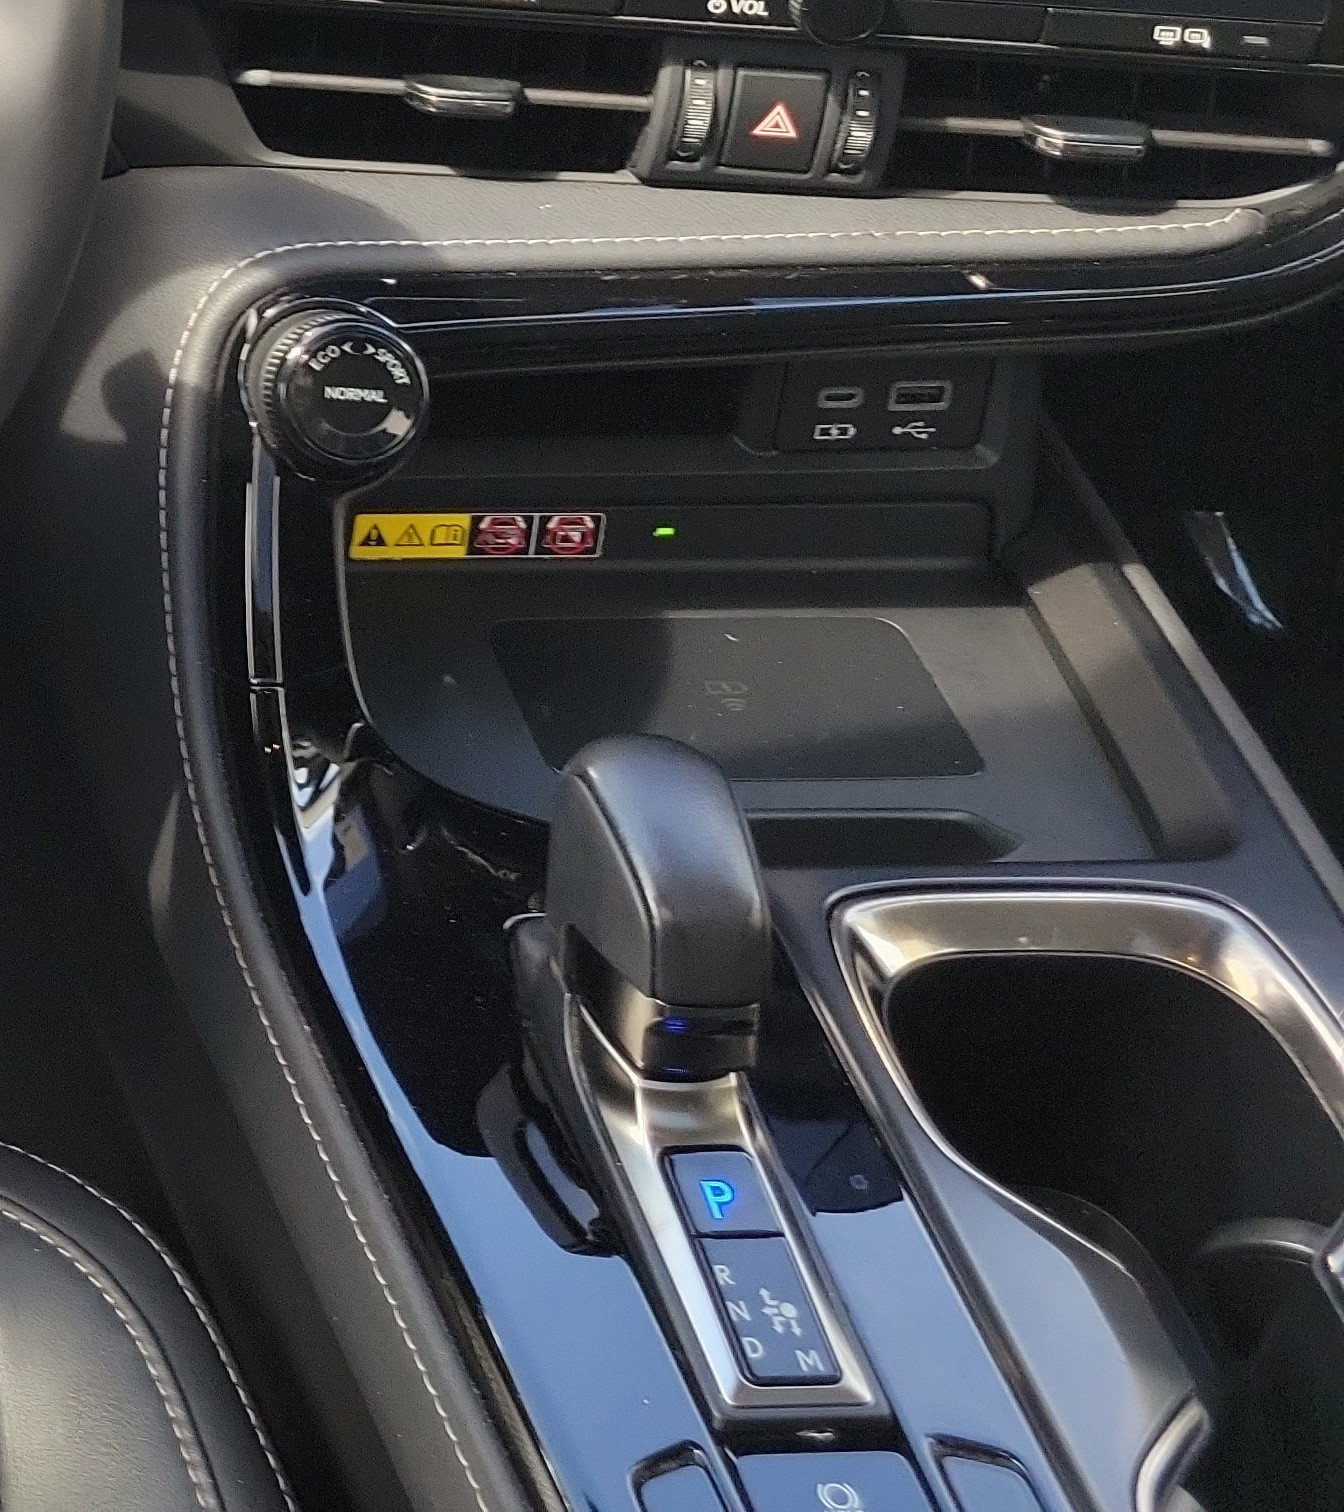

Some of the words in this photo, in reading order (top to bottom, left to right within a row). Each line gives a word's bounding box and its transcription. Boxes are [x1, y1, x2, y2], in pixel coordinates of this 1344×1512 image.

[307, 344, 341, 372] ECO
[373, 348, 411, 385] SPORT
[324, 385, 389, 403] NORMAL
[699, 1179, 734, 1219] P
[712, 1264, 736, 1285] R
[726, 1300, 752, 1322] N
[742, 1336, 764, 1359] D
[794, 1349, 825, 1372] M
